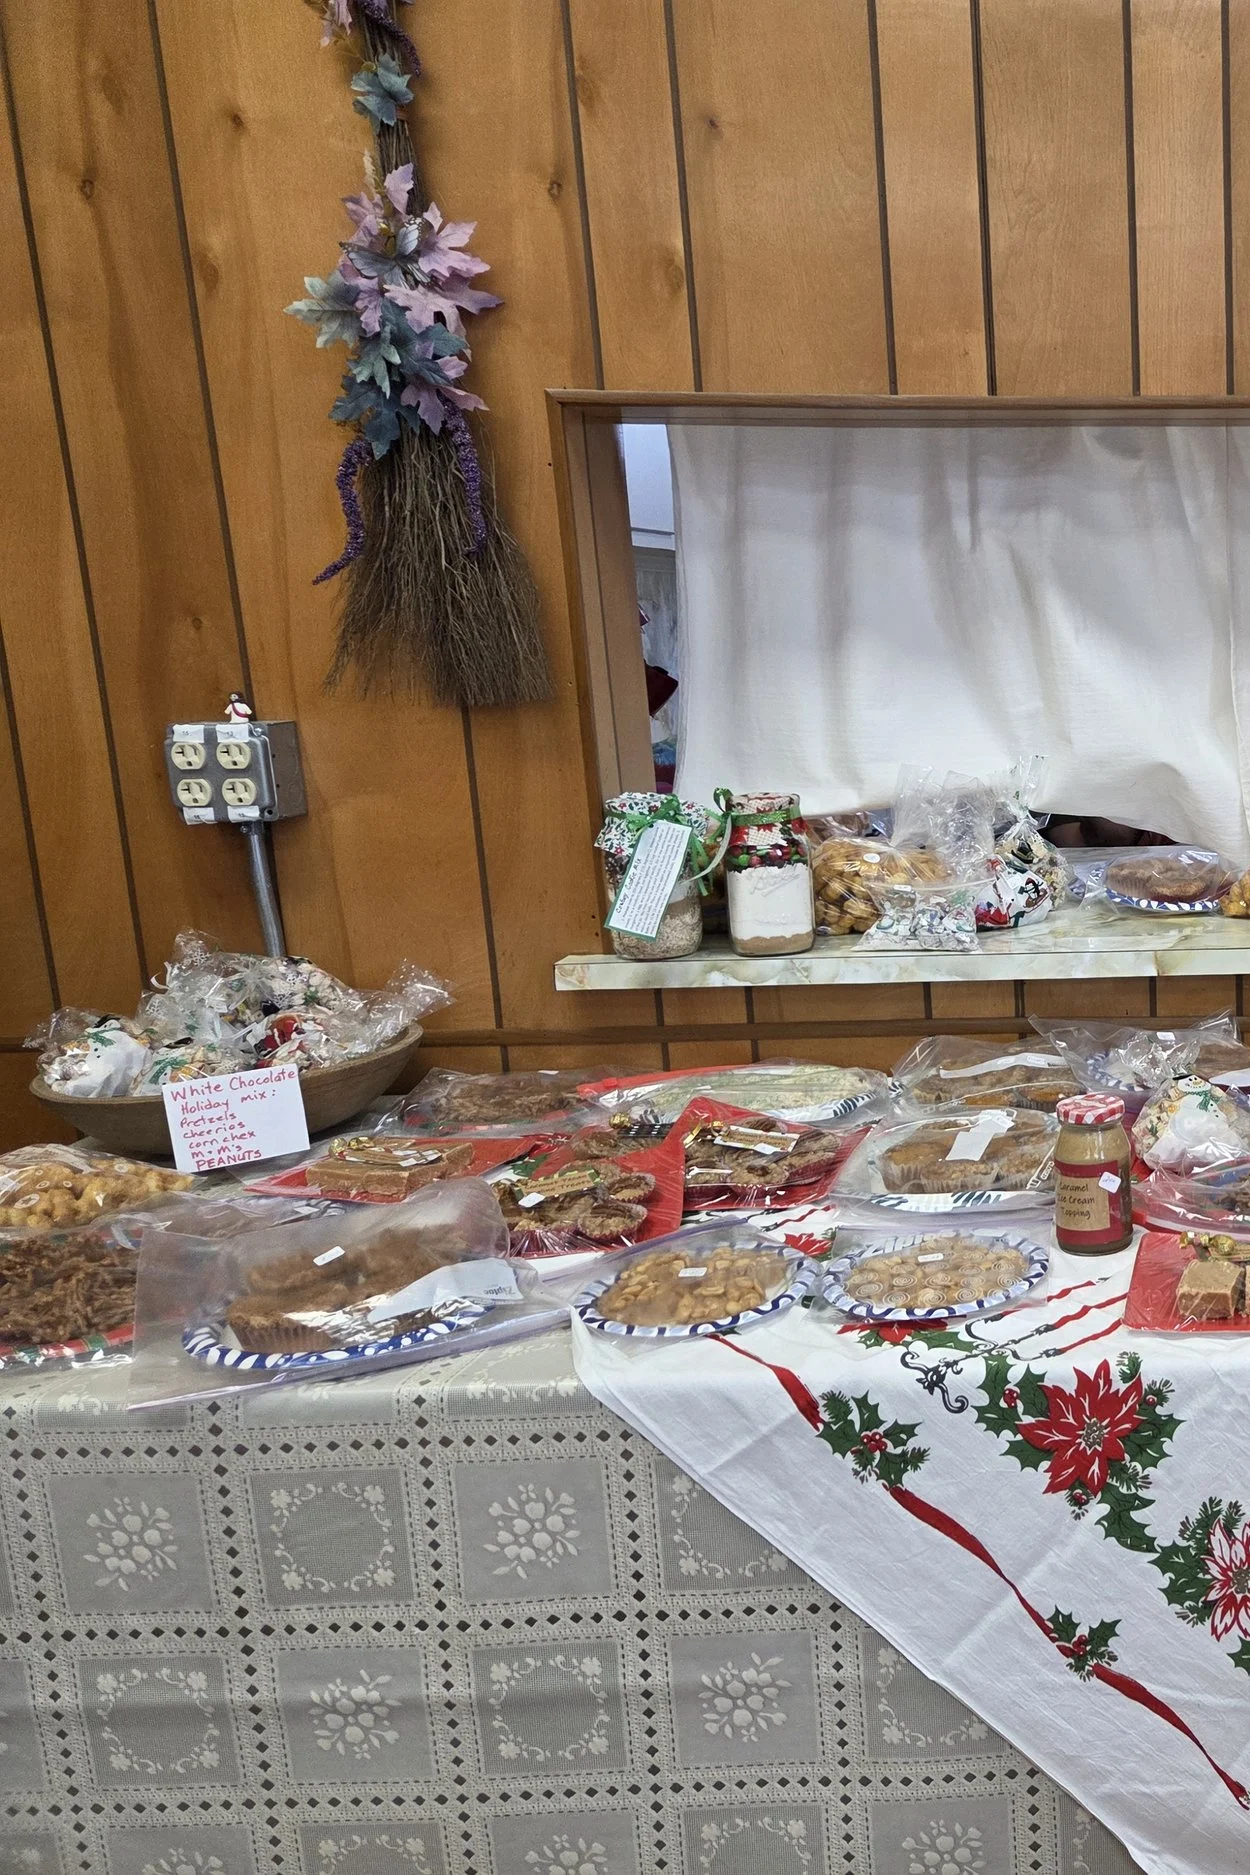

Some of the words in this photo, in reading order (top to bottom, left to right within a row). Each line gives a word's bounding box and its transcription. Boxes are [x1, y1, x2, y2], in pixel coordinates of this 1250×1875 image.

[170, 1081, 223, 1102] White
[229, 1068, 297, 1091] Chocolate
[181, 1098, 229, 1115] Holiday
[180, 1111, 237, 1129] Pretzels
[183, 1121, 246, 1139] cheerios
[188, 1138, 218, 1150] corn
[223, 1131, 257, 1144] chex
[196, 1149, 263, 1171] PEANUTS
[1068, 1194, 1096, 1205] Cream
